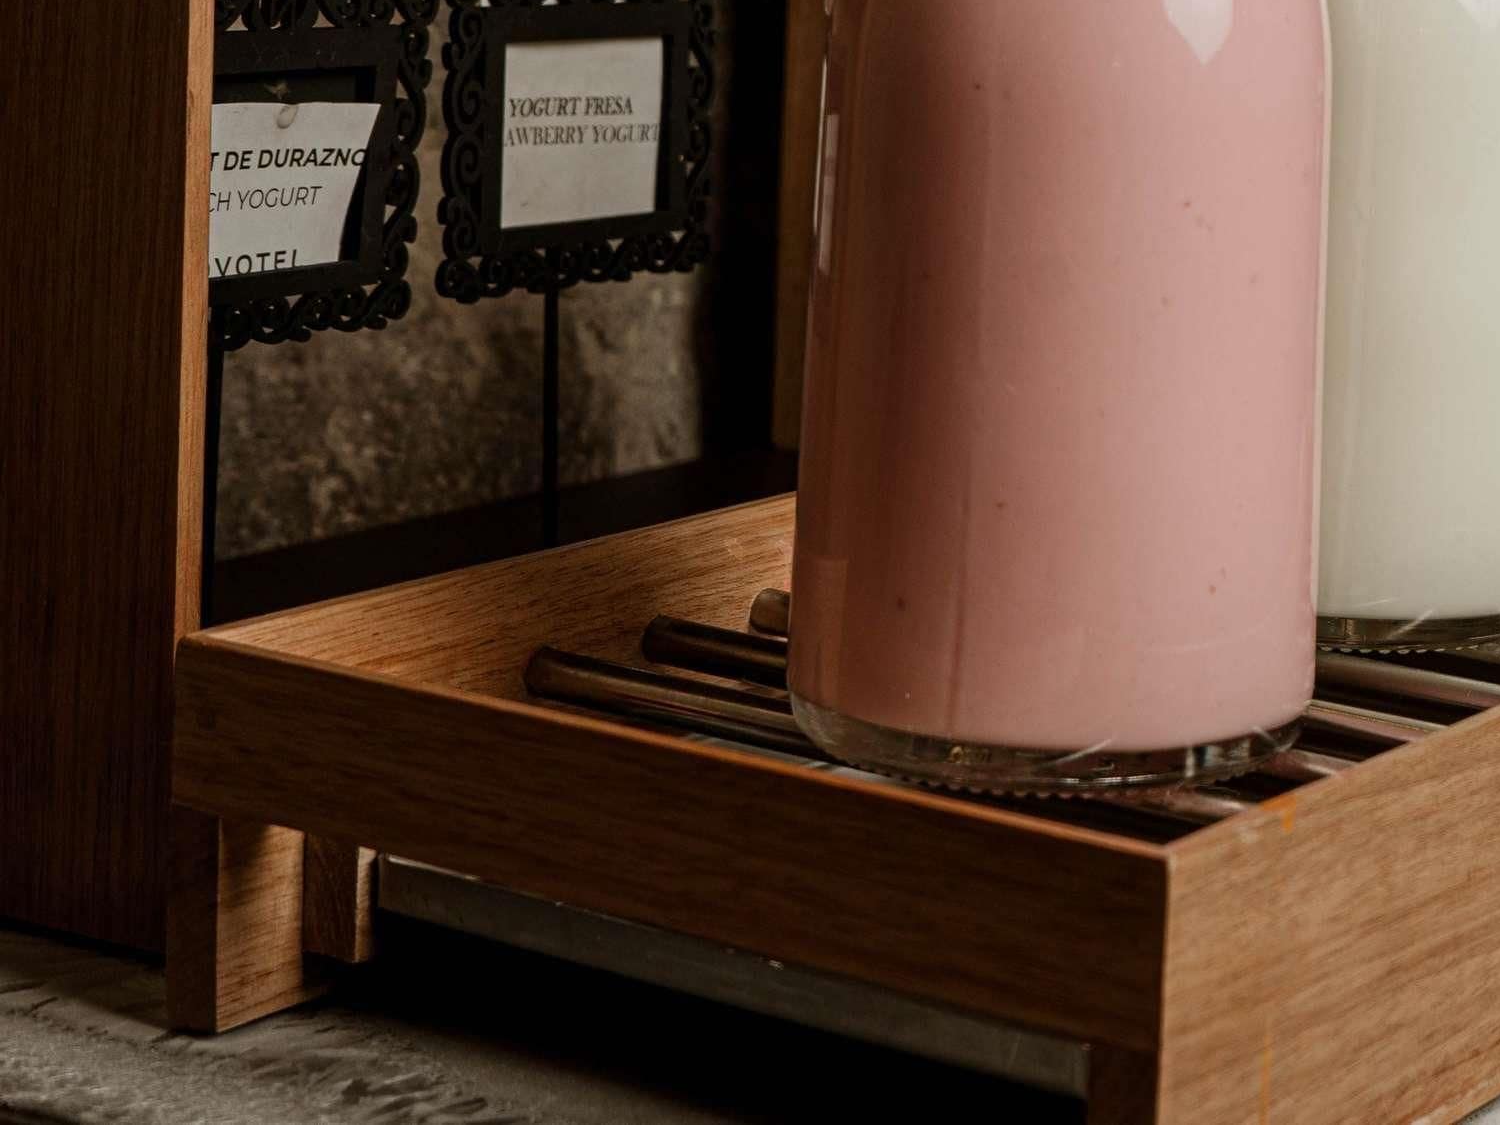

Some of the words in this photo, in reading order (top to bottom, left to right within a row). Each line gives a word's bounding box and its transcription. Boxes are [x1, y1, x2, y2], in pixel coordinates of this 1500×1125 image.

[509, 96, 582, 118] YOGURT
[584, 94, 633, 116] FRESA
[504, 124, 588, 147] AWBERRY
[223, 149, 253, 171] DE
[257, 147, 367, 169] DURAZNO
[237, 185, 324, 210] YOGURT
[208, 248, 297, 276] VOTEL
